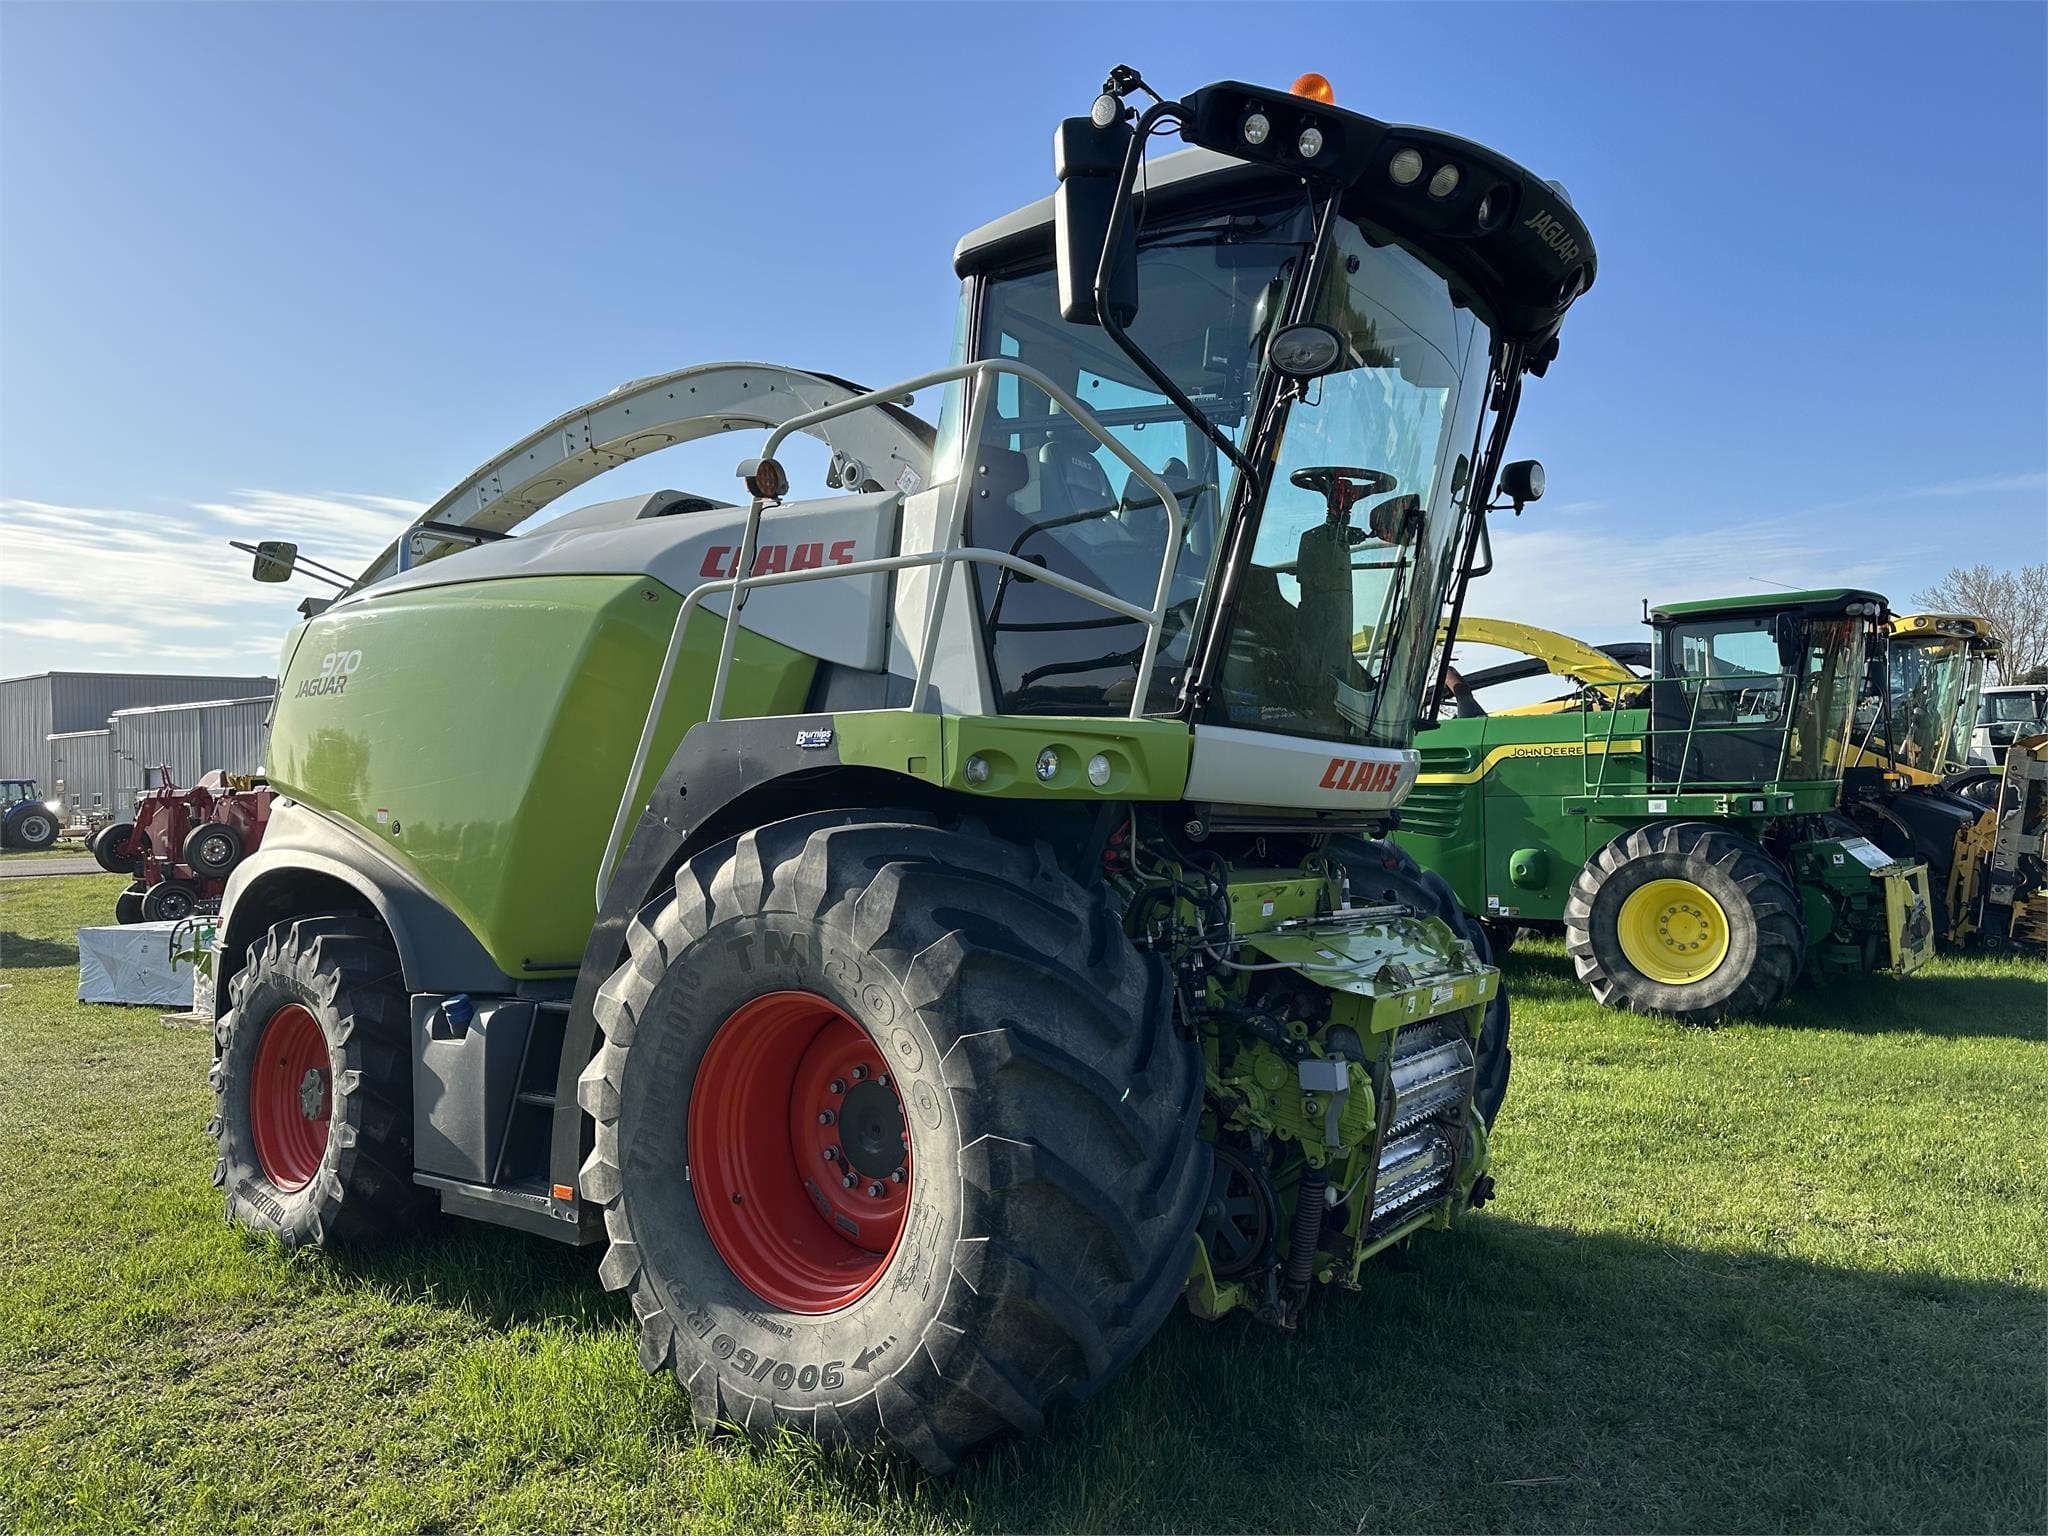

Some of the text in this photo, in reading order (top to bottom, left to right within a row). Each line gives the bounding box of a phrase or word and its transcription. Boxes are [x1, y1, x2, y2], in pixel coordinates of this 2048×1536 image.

[1523, 209, 1580, 265] JAGUAR
[320, 649, 362, 678] 970
[295, 675, 347, 698] JAGUAR
[795, 728, 832, 744] Burnips
[1511, 746, 1583, 757] JOHN DEERE
[1319, 758, 1402, 792] CLAAS
[711, 1333, 845, 1392] 900/60
